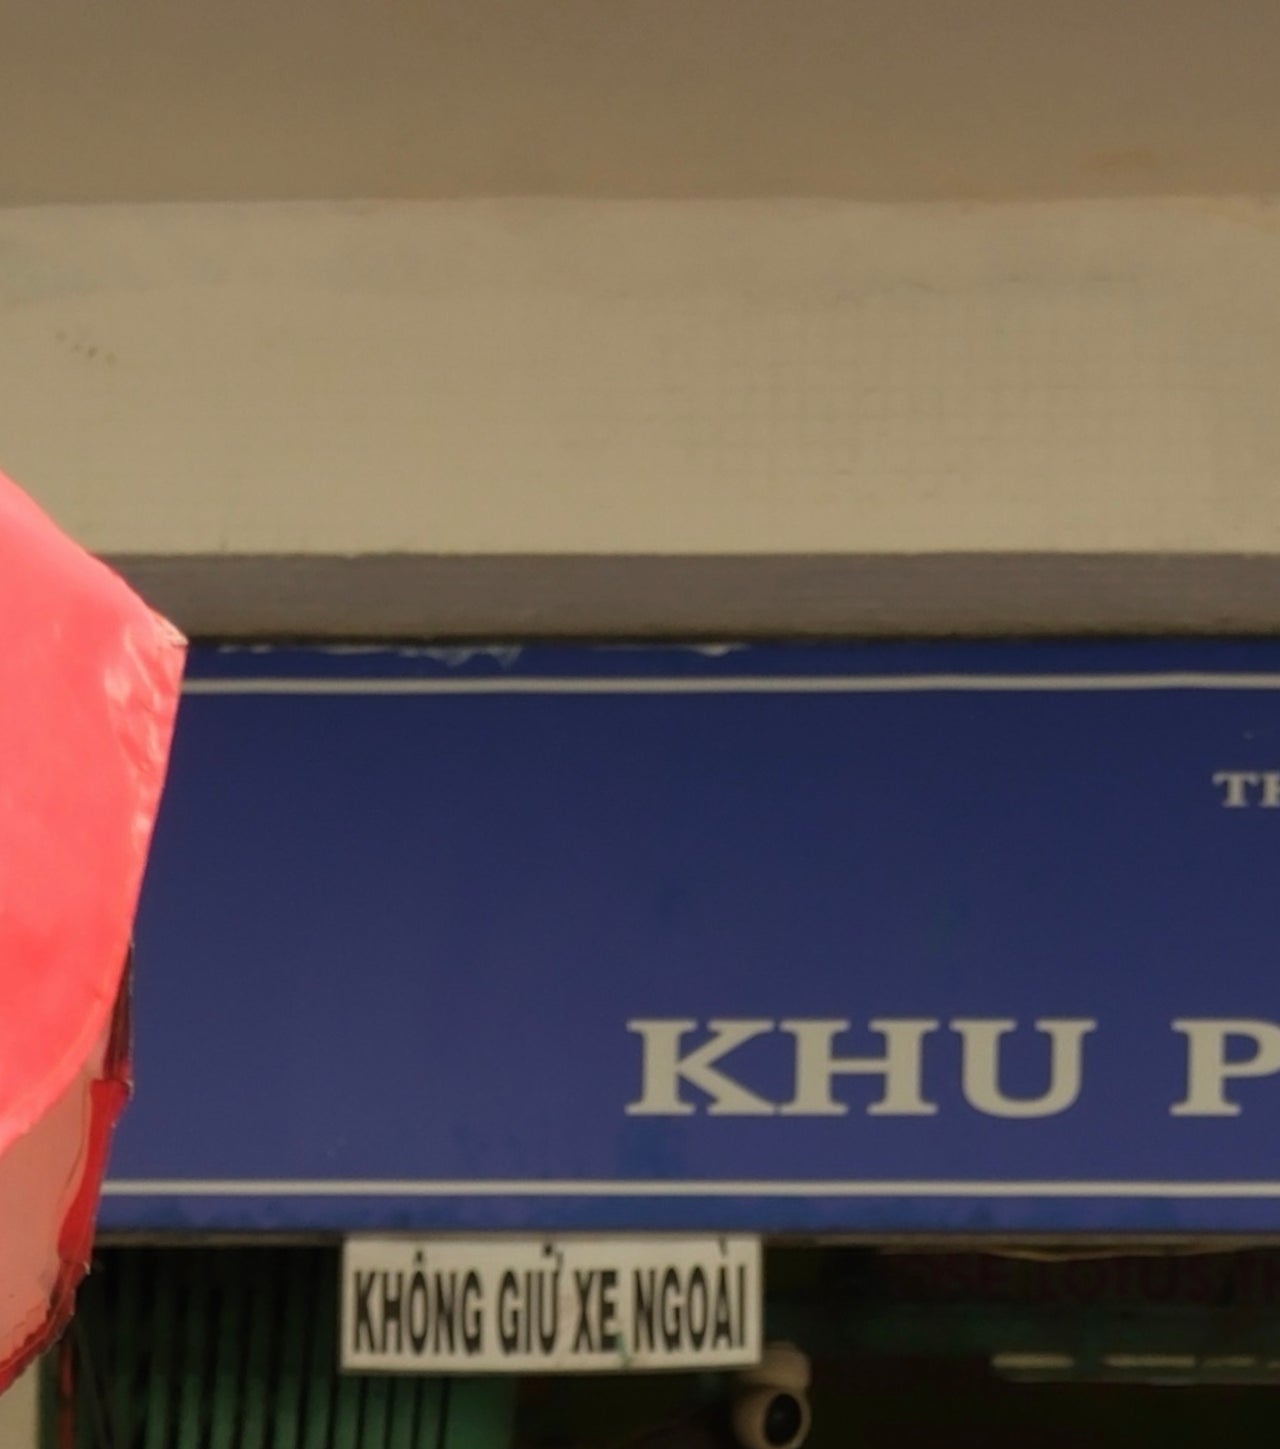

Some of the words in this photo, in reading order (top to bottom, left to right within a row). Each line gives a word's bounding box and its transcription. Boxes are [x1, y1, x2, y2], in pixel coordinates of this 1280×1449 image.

[624, 1018, 1097, 1119] KHU
[353, 1250, 483, 1356] KHÔNG
[498, 1243, 564, 1356] GIỮ
[570, 1269, 619, 1354] XE
